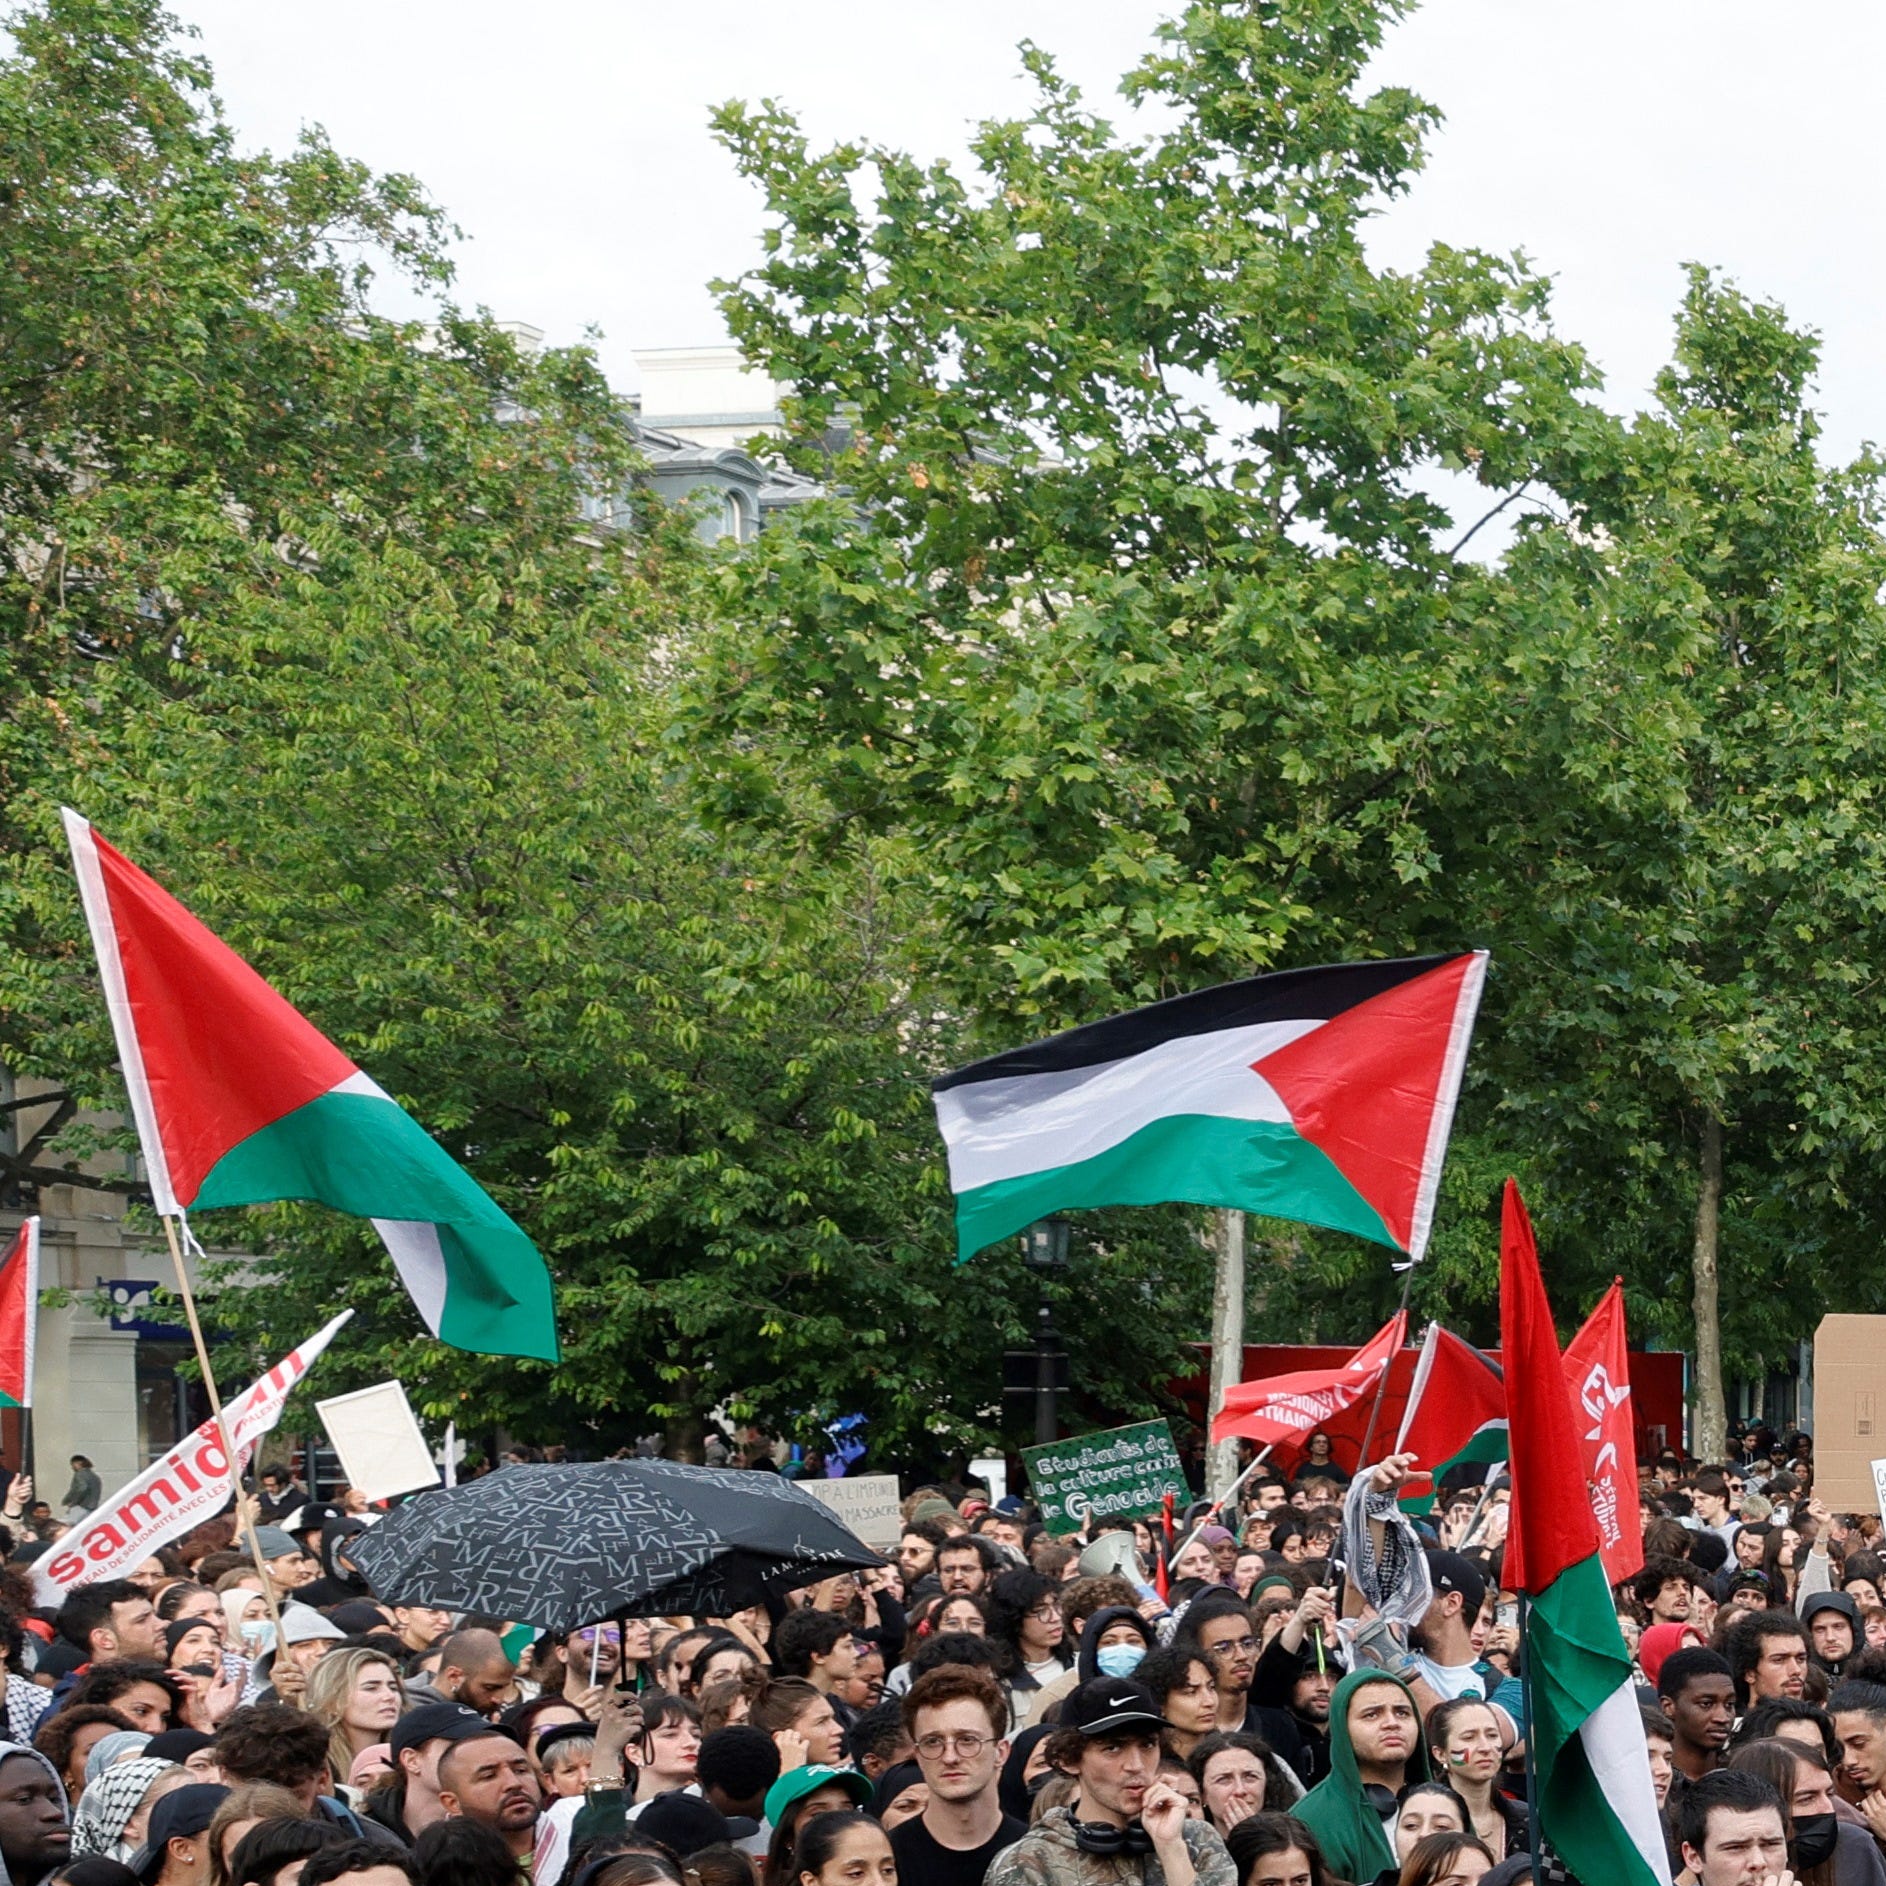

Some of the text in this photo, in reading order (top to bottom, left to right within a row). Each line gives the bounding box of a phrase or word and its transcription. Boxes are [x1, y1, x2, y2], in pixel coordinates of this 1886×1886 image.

[1143, 1434, 1171, 1455] de
[1035, 1480, 1058, 1498] la
[1059, 1463, 1134, 1493] culture
[1040, 1502, 1063, 1520] le
[108, 1553, 126, 1571] DE
[122, 1511, 178, 1565] SOLIDARITÉ
[178, 1494, 208, 1518] AVEC
[206, 1484, 229, 1503] LES
